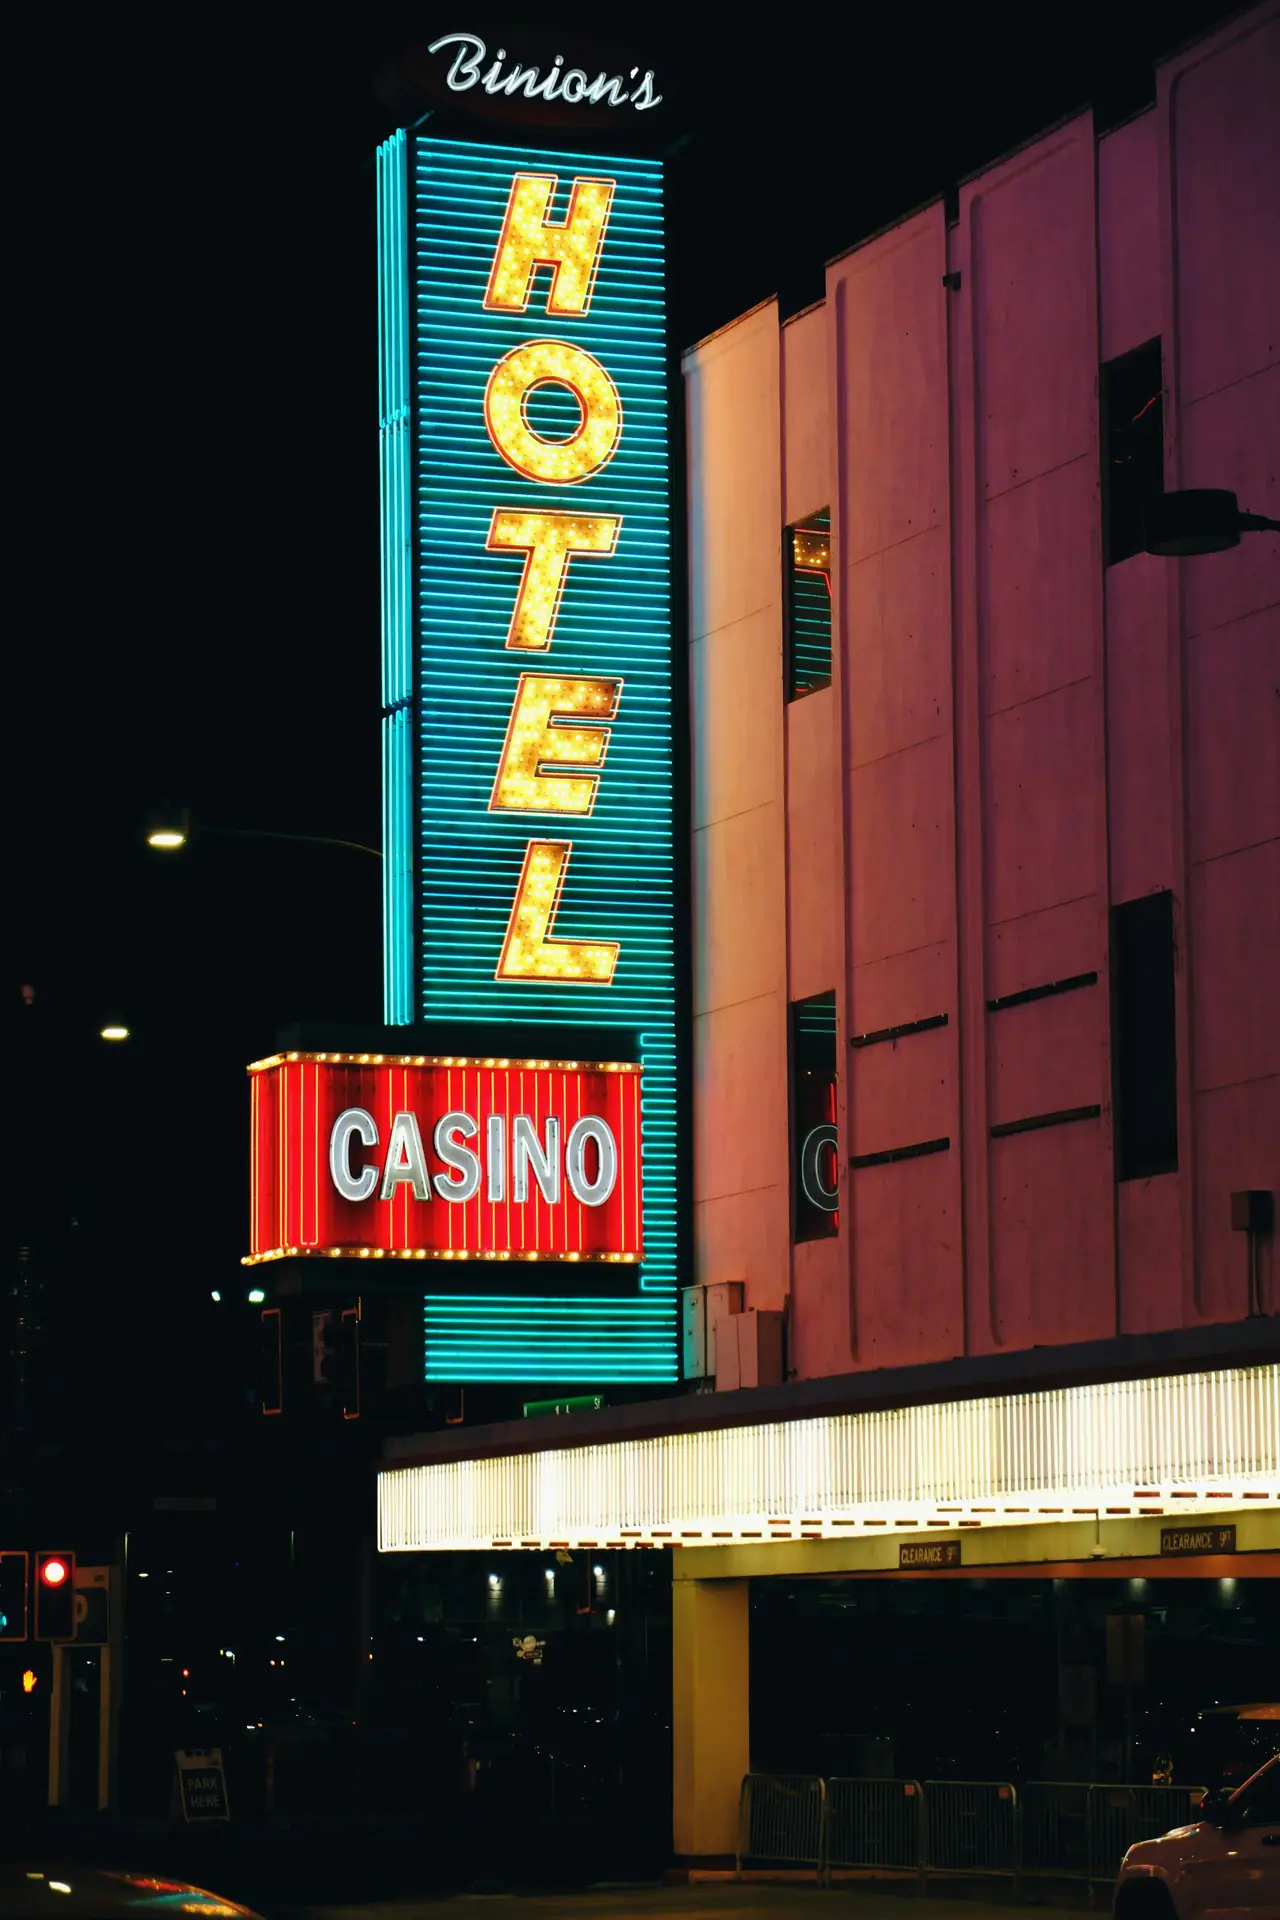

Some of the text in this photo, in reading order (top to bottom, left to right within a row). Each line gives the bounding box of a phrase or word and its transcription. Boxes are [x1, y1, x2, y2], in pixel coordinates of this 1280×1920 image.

[428, 33, 663, 110] Binion's
[483, 172, 624, 986] HOTEL
[329, 1107, 617, 1207] CASINO
[1163, 1532, 1213, 1551] CLEARANCE
[901, 1547, 942, 1564] CLEARANCE
[187, 1777, 218, 1791] PARK
[190, 1794, 221, 1808] HERE
